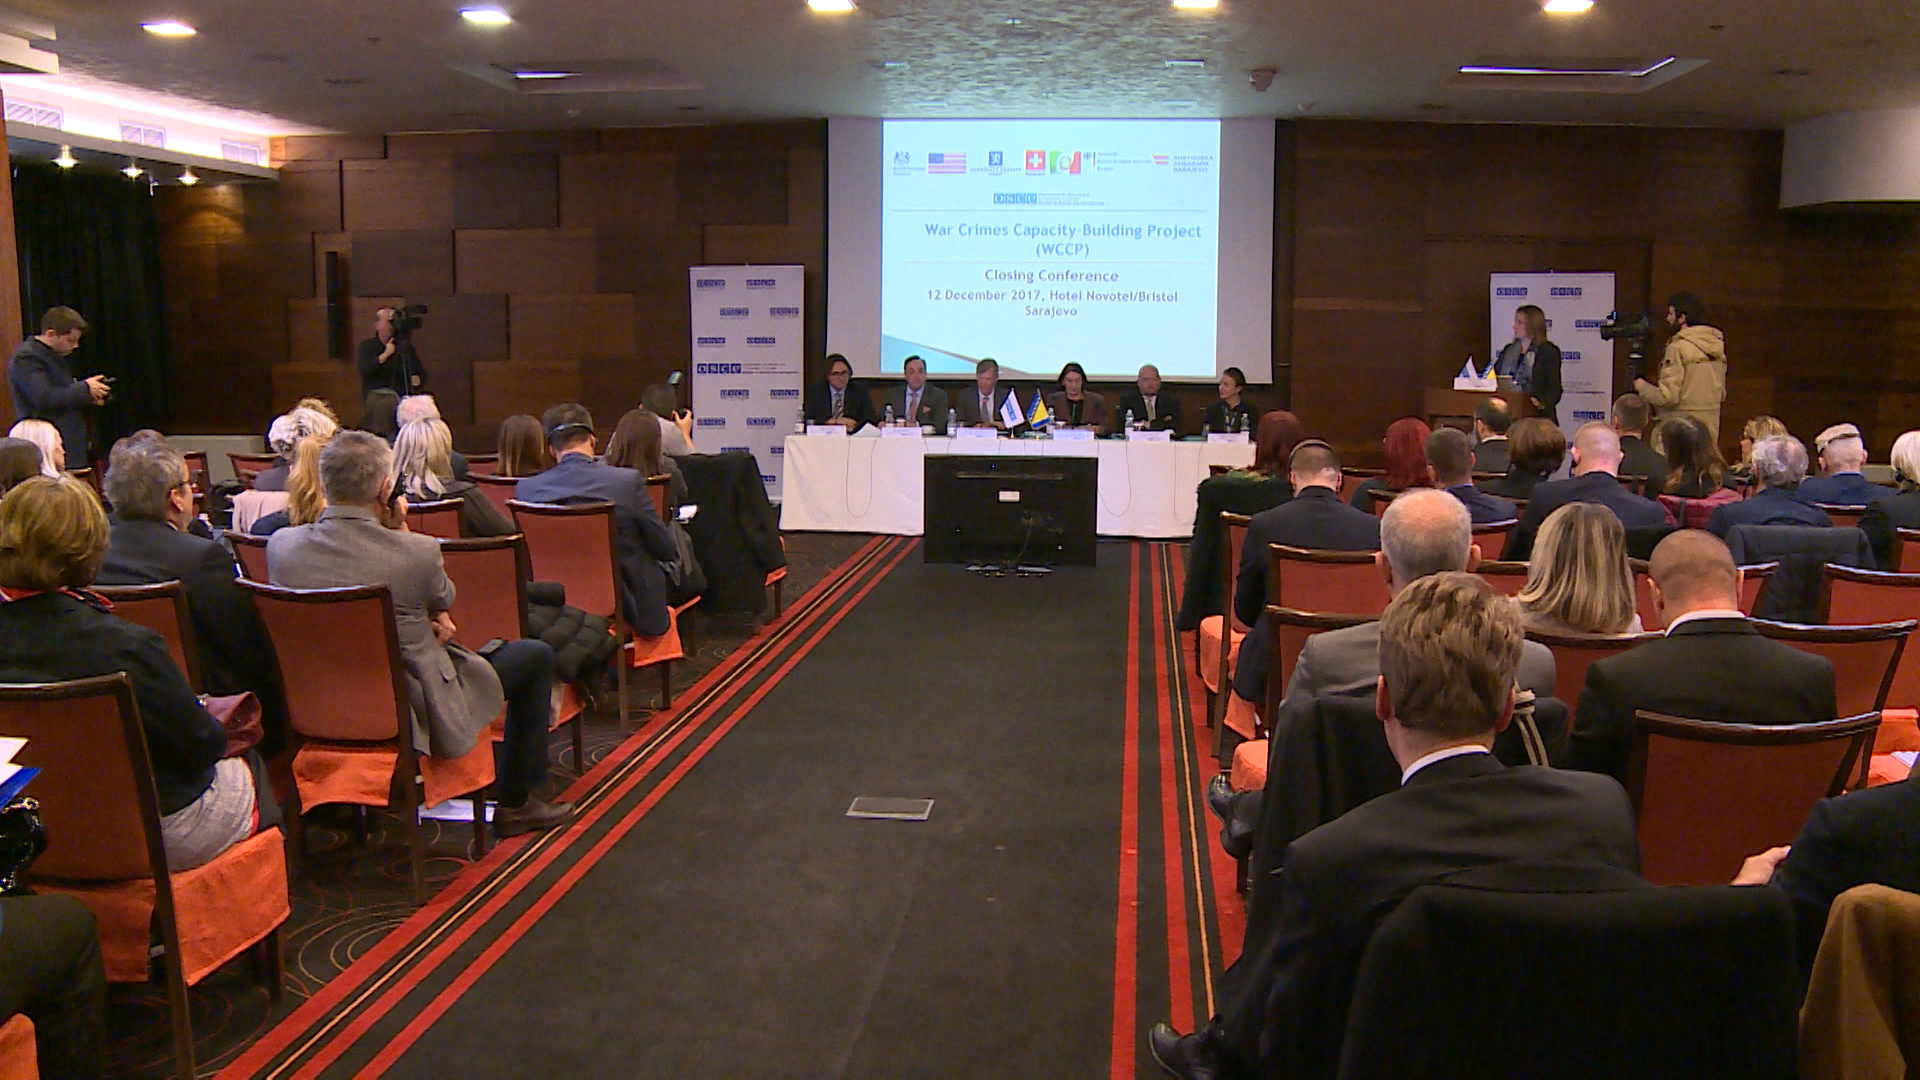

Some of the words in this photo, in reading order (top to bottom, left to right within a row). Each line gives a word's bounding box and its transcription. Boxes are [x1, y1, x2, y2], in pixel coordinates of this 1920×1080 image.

[924, 223, 952, 236] War
[958, 223, 1009, 236] Crimes
[1013, 223, 1143, 239] Capacity-Building
[1147, 224, 1202, 239] Project
[1035, 242, 1090, 258] (WCCP)
[984, 269, 1034, 284] Closing
[1038, 269, 1119, 283] Conference
[928, 289, 942, 301] 12
[945, 289, 1007, 301] December
[1011, 289, 1045, 303] 2017,
[1049, 290, 1082, 302] Hotel
[1086, 290, 1178, 303] Novotel/Bristol
[1025, 305, 1078, 318] Sarajevo
